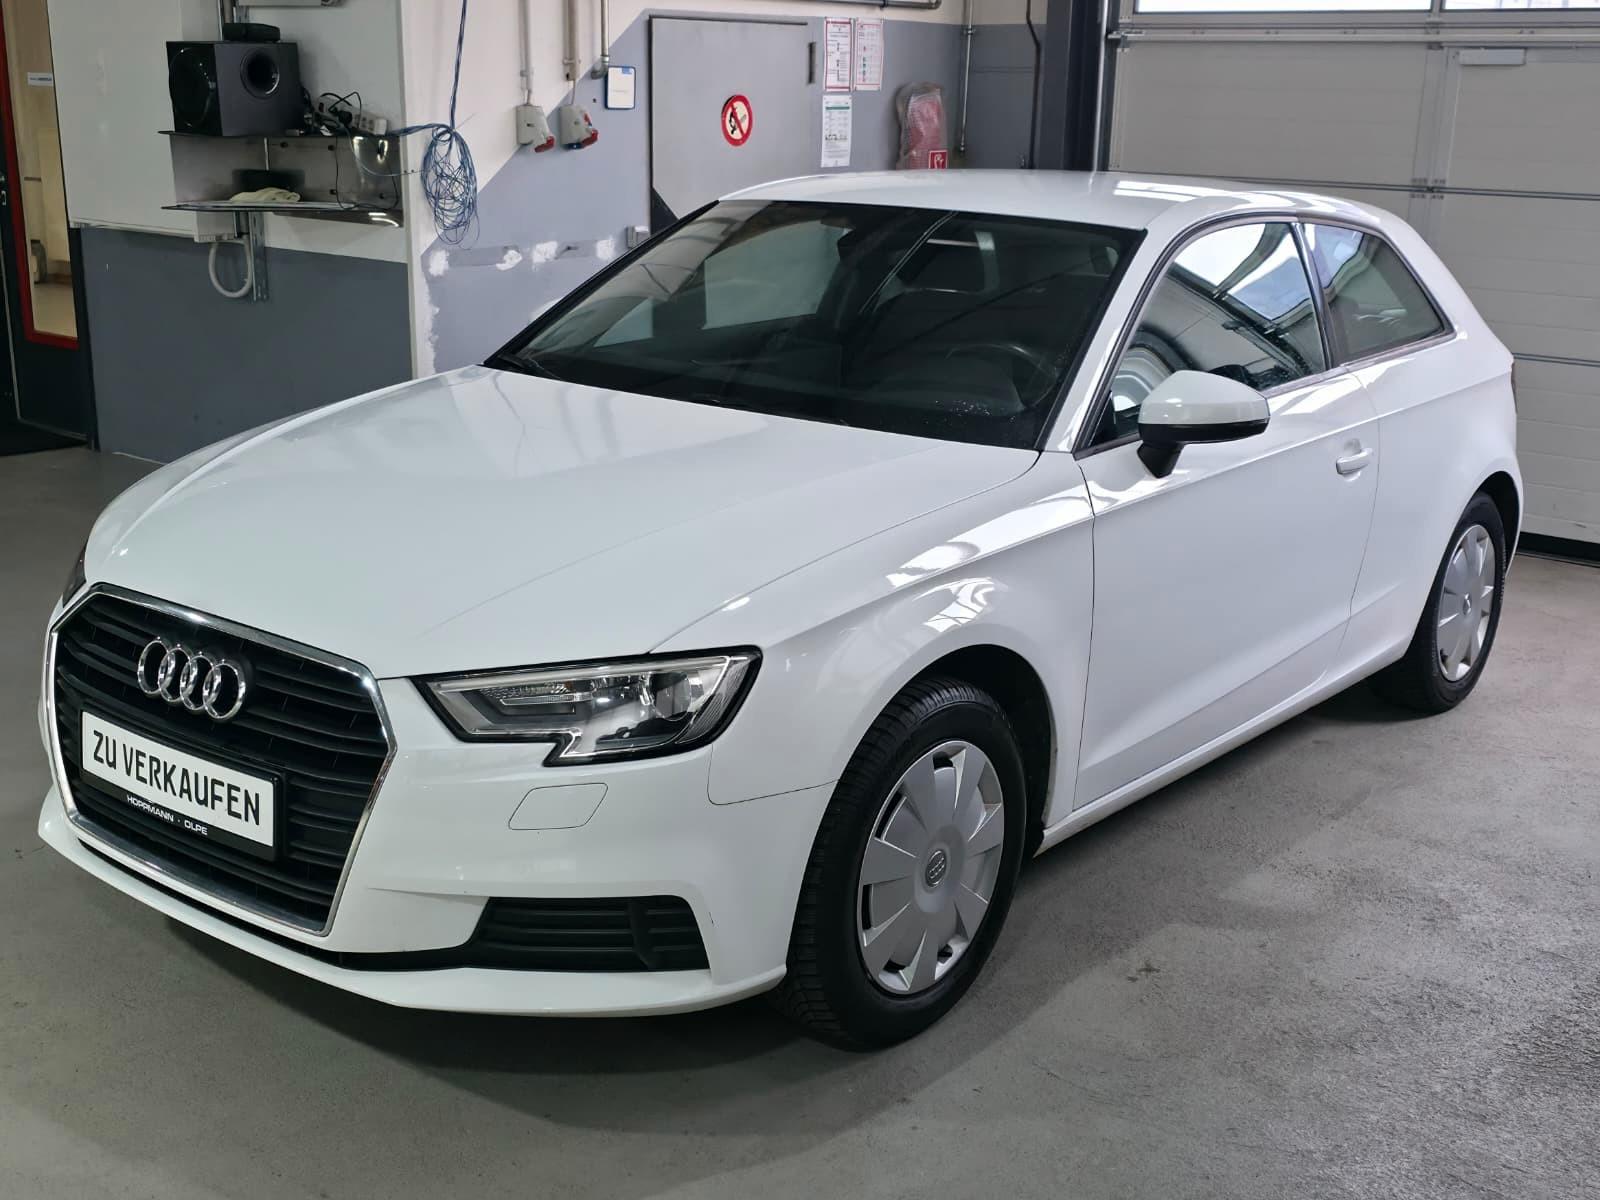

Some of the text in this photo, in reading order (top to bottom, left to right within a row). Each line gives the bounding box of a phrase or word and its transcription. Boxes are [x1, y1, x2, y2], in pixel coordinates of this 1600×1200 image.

[93, 730, 260, 826] ZU VERKAUFEN
[184, 819, 208, 836] OLPE
